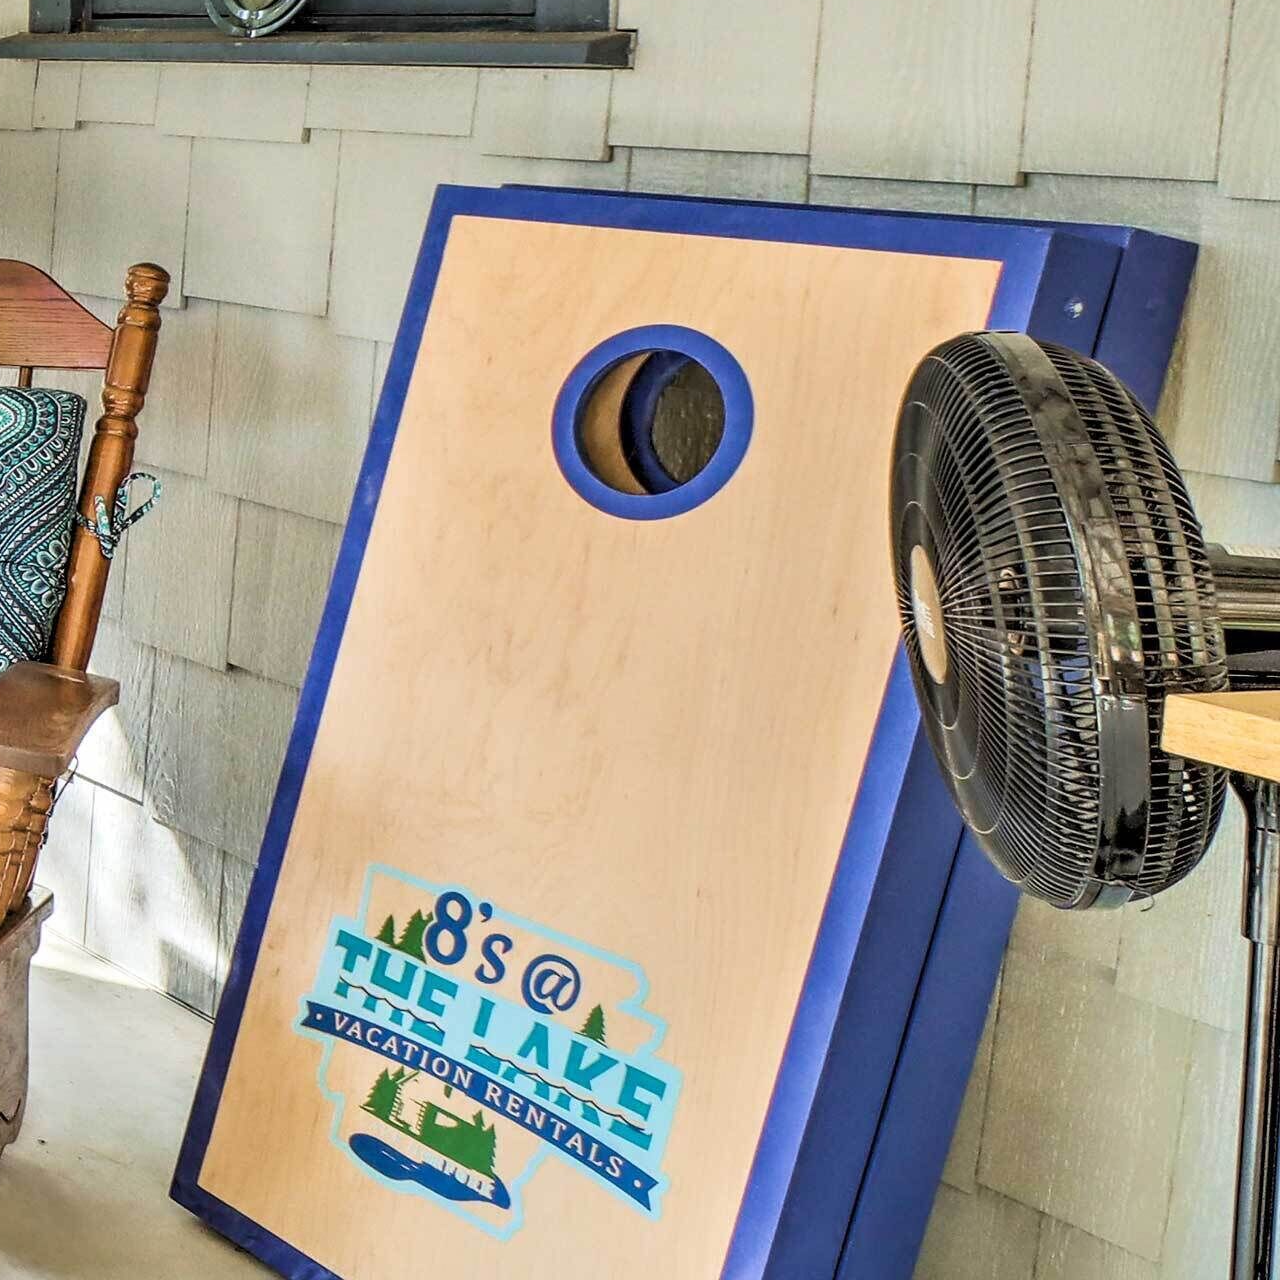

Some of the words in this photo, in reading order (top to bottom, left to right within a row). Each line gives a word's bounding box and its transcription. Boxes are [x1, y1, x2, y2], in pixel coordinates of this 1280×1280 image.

[333, 929, 459, 1046] THE
[464, 996, 667, 1151] LAKE
[521, 954, 581, 1015] @
[333, 1012, 474, 1089] VACATION
[483, 1083, 625, 1178] RENTALS
